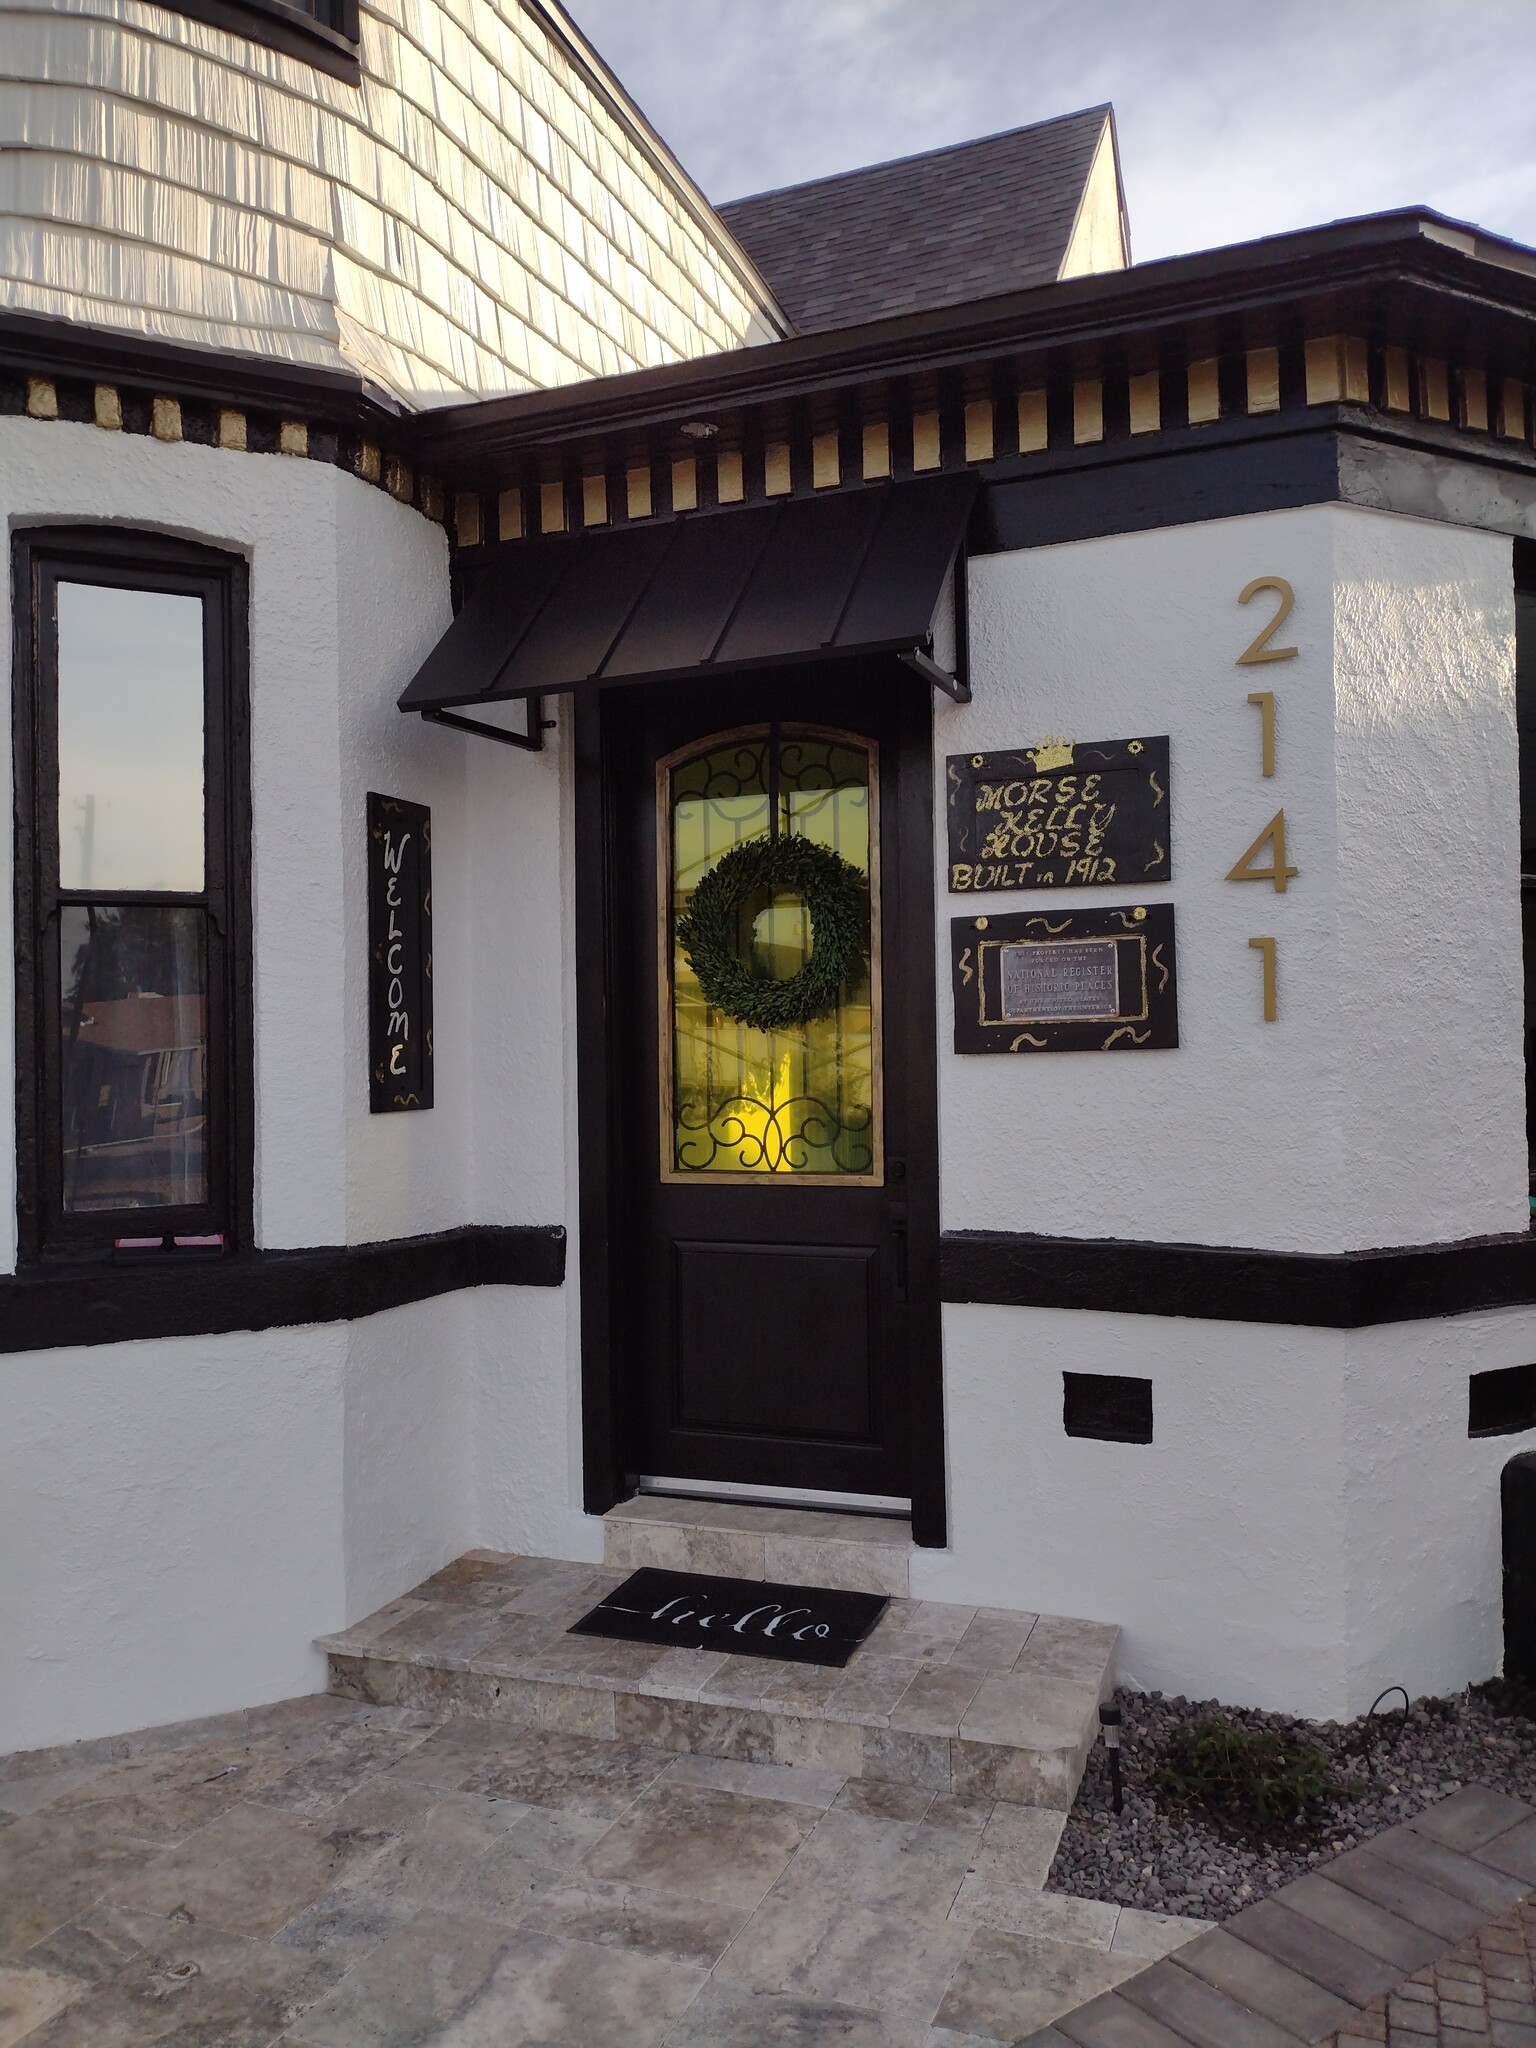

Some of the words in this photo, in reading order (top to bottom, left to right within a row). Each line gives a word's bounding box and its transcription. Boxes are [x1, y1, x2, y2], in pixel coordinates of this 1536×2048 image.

[976, 774, 1102, 812] MORSE
[1224, 575, 1299, 1022] 2141
[995, 803, 1117, 836] KELLY
[979, 831, 1106, 859] HOUSE
[952, 862, 1035, 890] BUILT
[1065, 857, 1117, 884] 1912
[383, 830, 411, 1076] WELCOME
[1007, 968, 1057, 979] NATIONAL
[1063, 965, 1113, 977] REGISTER
[1007, 984, 1019, 994] OF
[1024, 982, 1070, 993] HISTORIC
[1074, 980, 1113, 991] PLACES
[598, 1594, 866, 1643] hello
